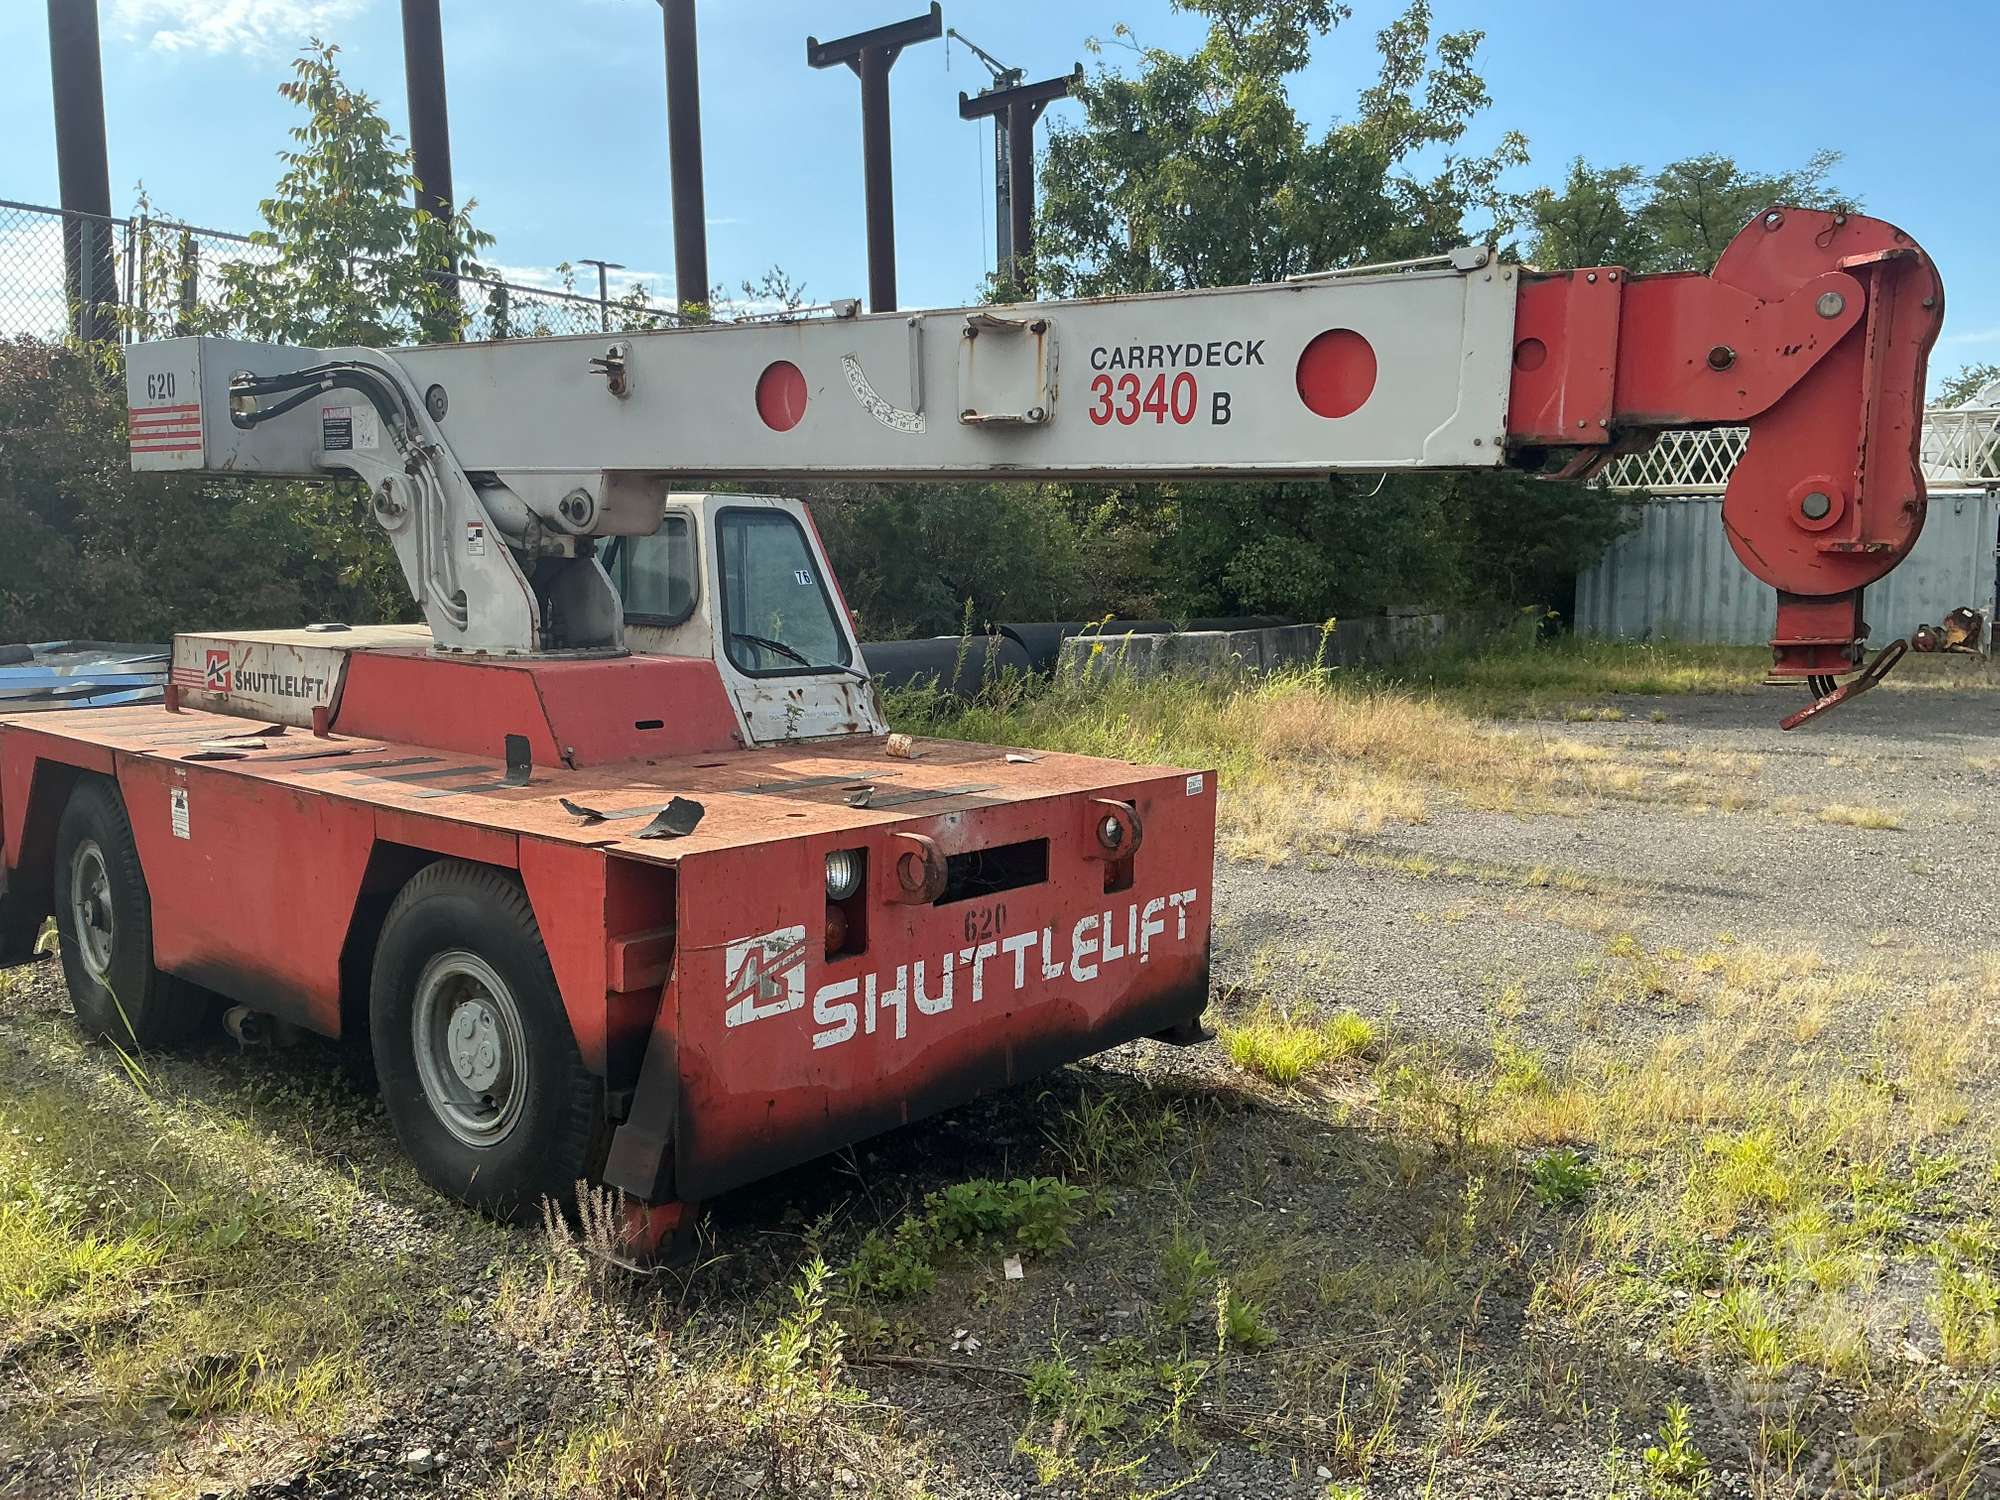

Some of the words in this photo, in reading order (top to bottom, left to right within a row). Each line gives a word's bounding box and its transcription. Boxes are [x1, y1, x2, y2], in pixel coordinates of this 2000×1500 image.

[1090, 340, 1265, 371] CARRYDECK
[147, 372, 176, 400] 620
[1089, 372, 1198, 426] 3340
[1211, 392, 1232, 425] B
[795, 571, 811, 584] 76
[235, 670, 324, 702] SHUTTLELIFT
[965, 904, 1007, 942] 620
[812, 888, 1197, 1050] SHUTTLELIFT
